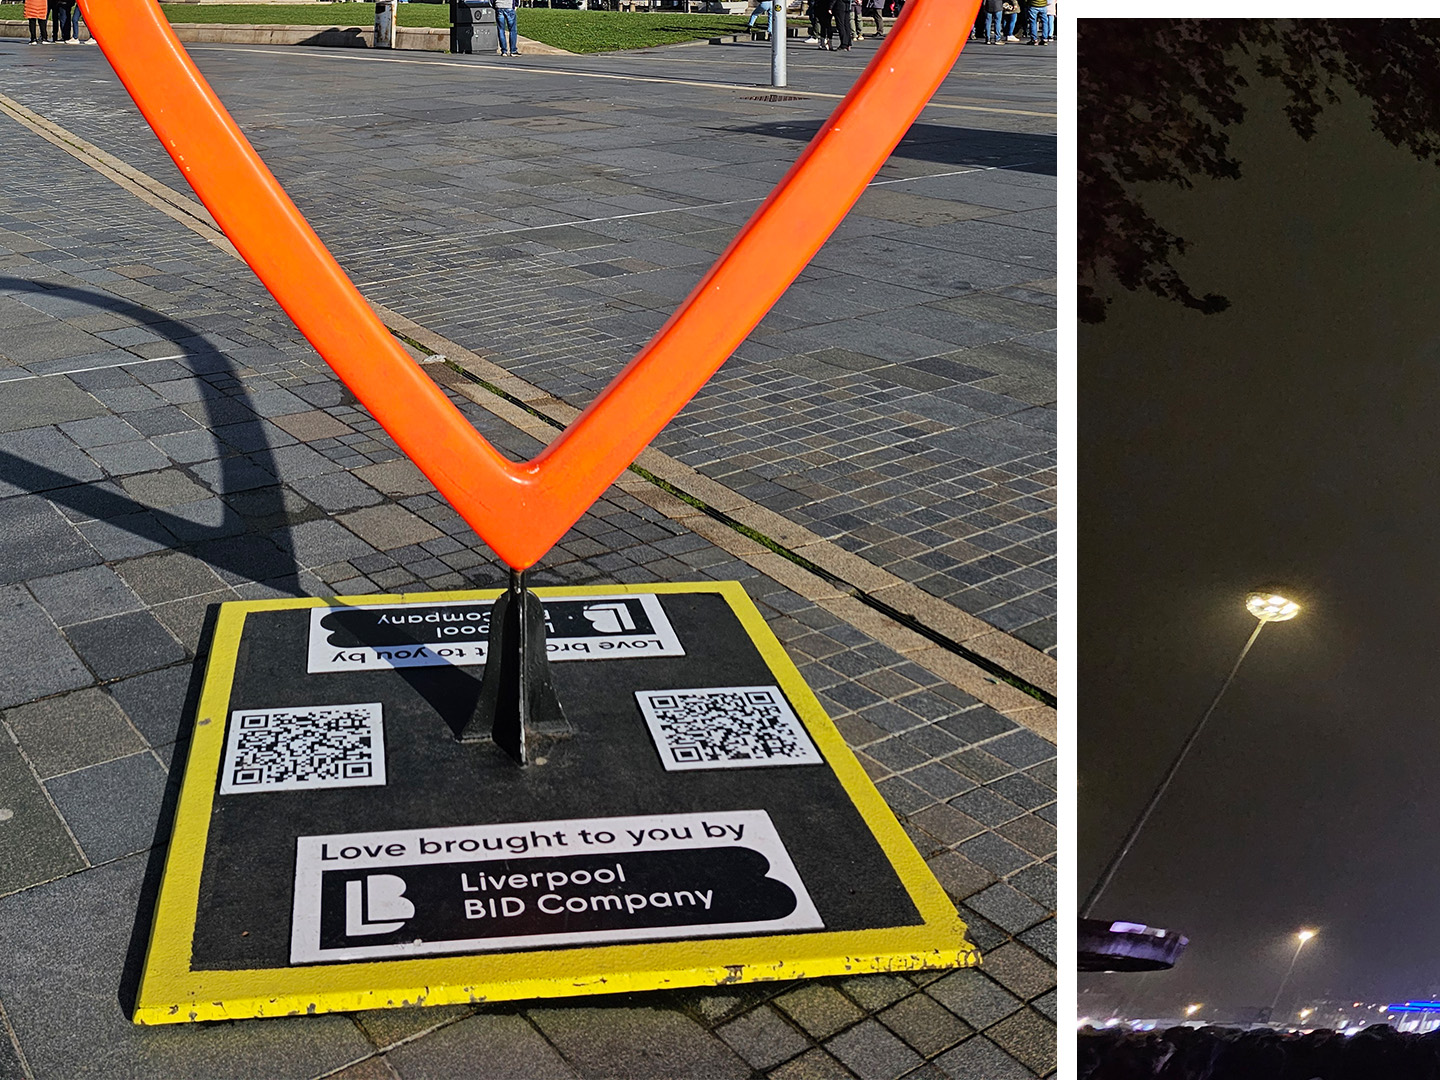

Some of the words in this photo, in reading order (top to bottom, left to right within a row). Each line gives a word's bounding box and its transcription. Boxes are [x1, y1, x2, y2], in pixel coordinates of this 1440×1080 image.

[437, 647, 466, 658] to
[599, 639, 665, 652] Love
[332, 650, 367, 664] by
[376, 647, 428, 661] you
[321, 843, 407, 861] Love
[419, 831, 568, 854] brought
[578, 830, 616, 845] to
[626, 826, 693, 847] you
[701, 821, 745, 841] by
[460, 863, 626, 892] Liverpool
[464, 896, 526, 920] BID
[537, 889, 713, 915] Company
